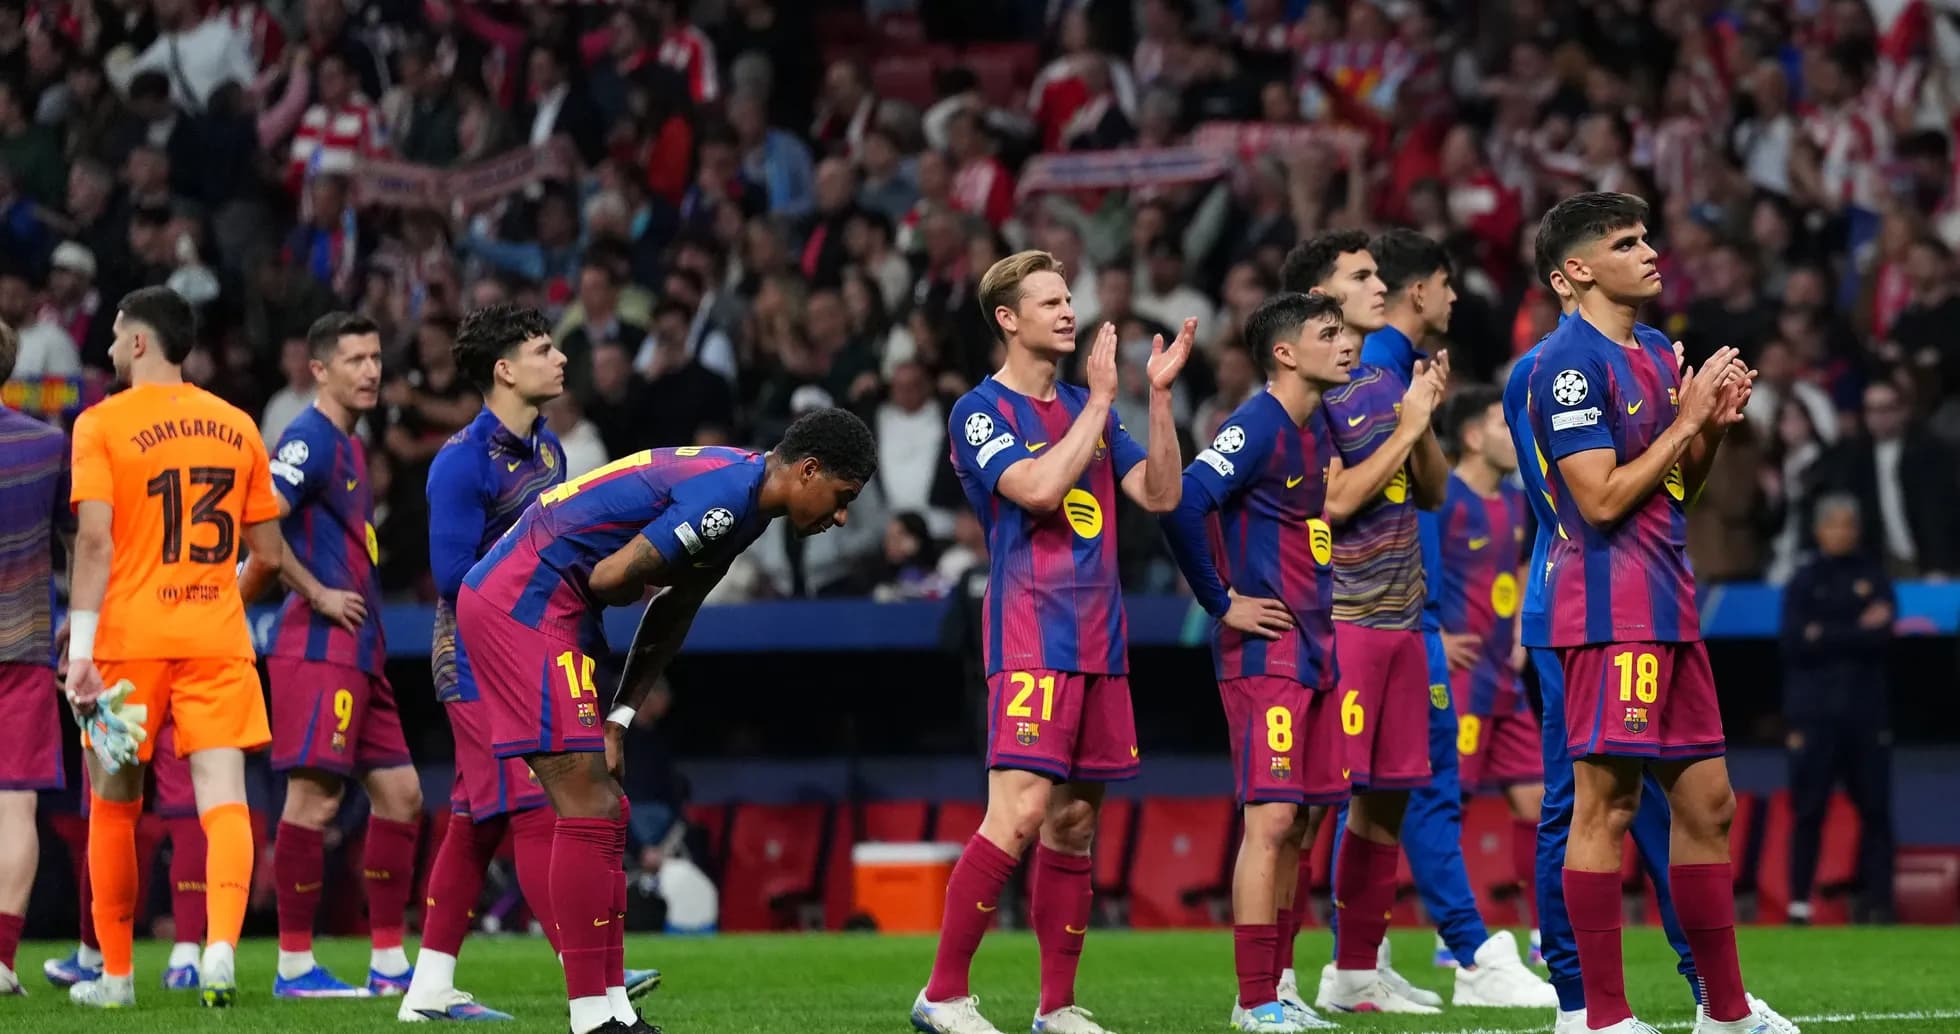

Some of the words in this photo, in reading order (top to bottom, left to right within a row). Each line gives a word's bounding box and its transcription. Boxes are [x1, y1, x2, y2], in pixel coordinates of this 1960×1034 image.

[130, 420, 178, 453] JOAN
[180, 419, 243, 451] GARCIA
[147, 467, 235, 564] 13
[556, 650, 598, 699] 14
[1006, 671, 1055, 721] 21
[1614, 651, 1658, 704] 18
[334, 688, 353, 732] 9
[1266, 706, 1293, 752] 8
[1341, 690, 1364, 735] 6
